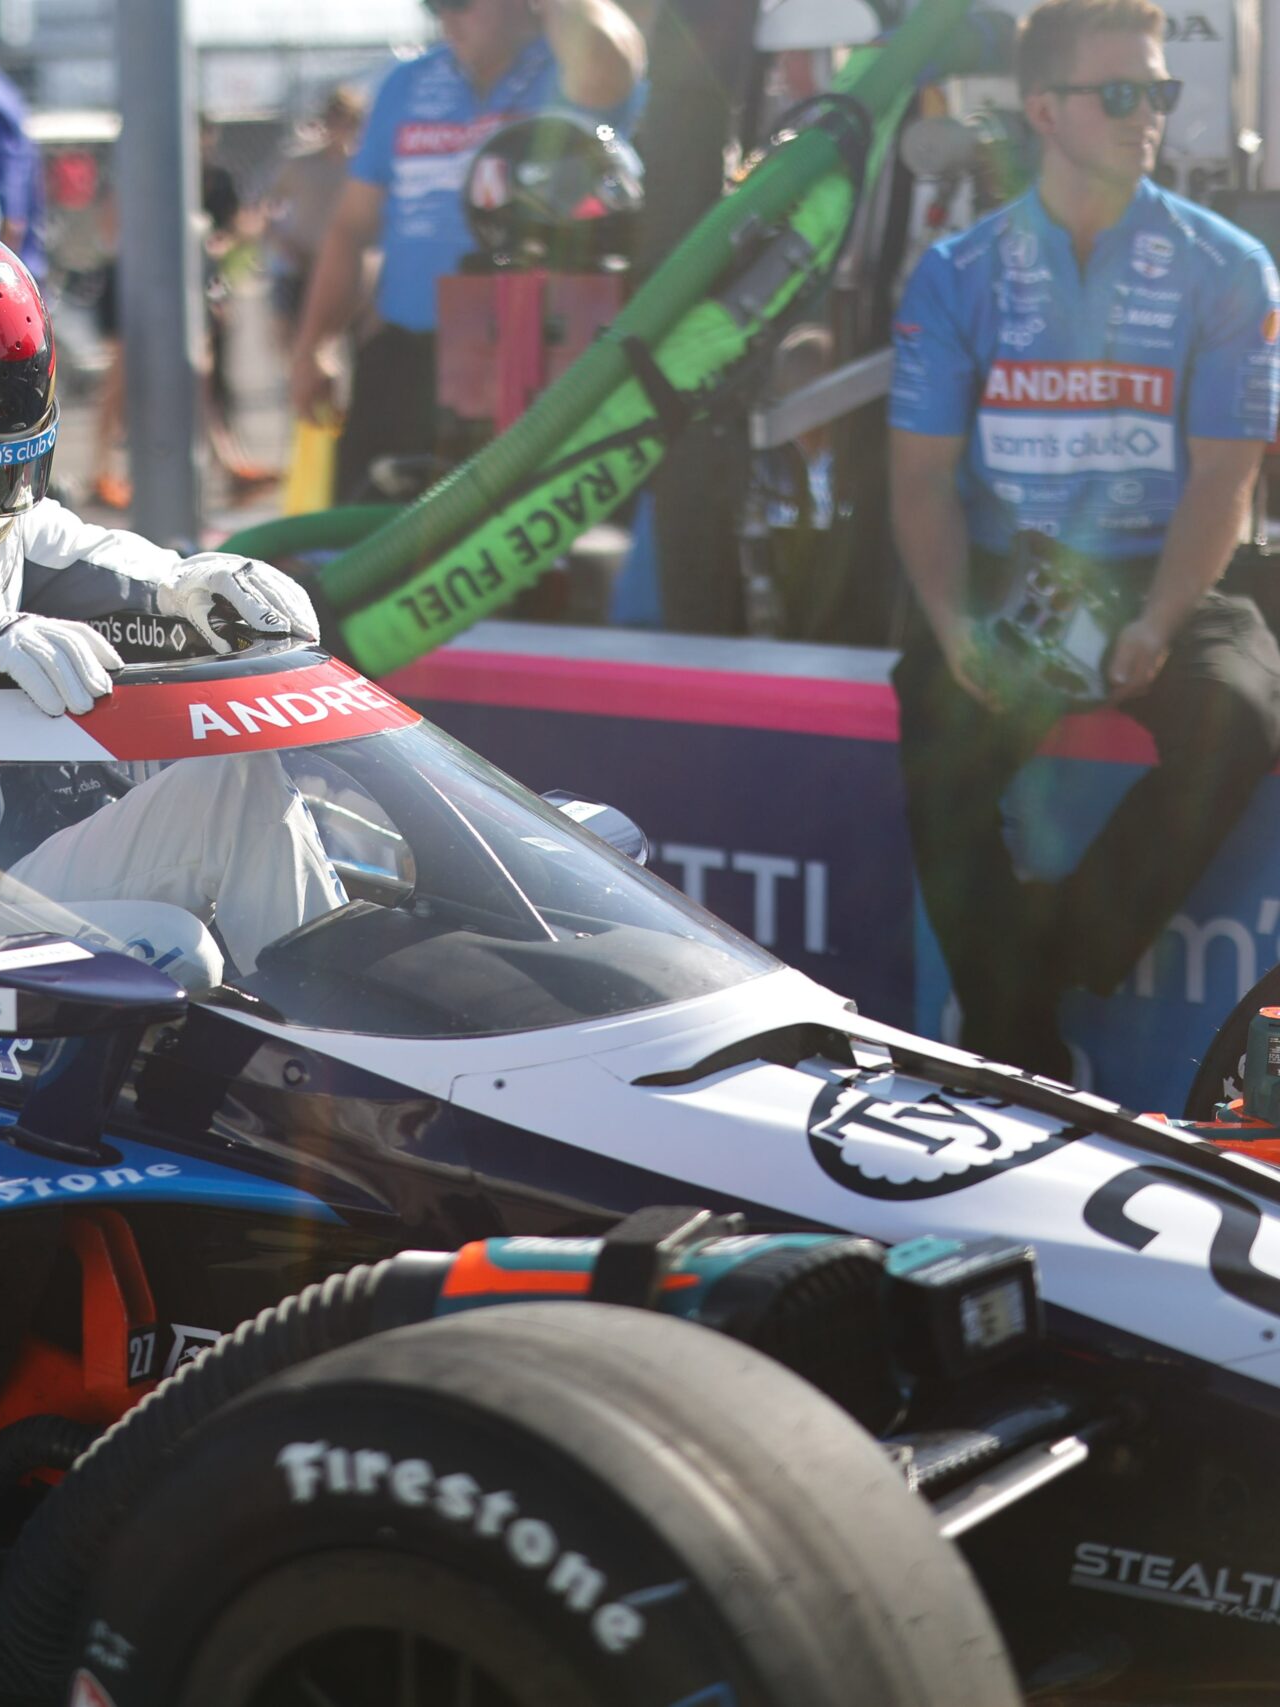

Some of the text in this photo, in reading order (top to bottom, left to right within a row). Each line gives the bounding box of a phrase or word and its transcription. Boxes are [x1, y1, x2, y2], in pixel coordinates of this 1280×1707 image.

[985, 367, 1164, 406] ANDRETTI
[17, 438, 47, 461] club
[398, 462, 619, 631] RACE FUEL
[87, 616, 166, 648] m's club
[189, 676, 398, 740] ANDRE
[130, 1332, 156, 1379] 27
[277, 1441, 645, 1653] Firestone
